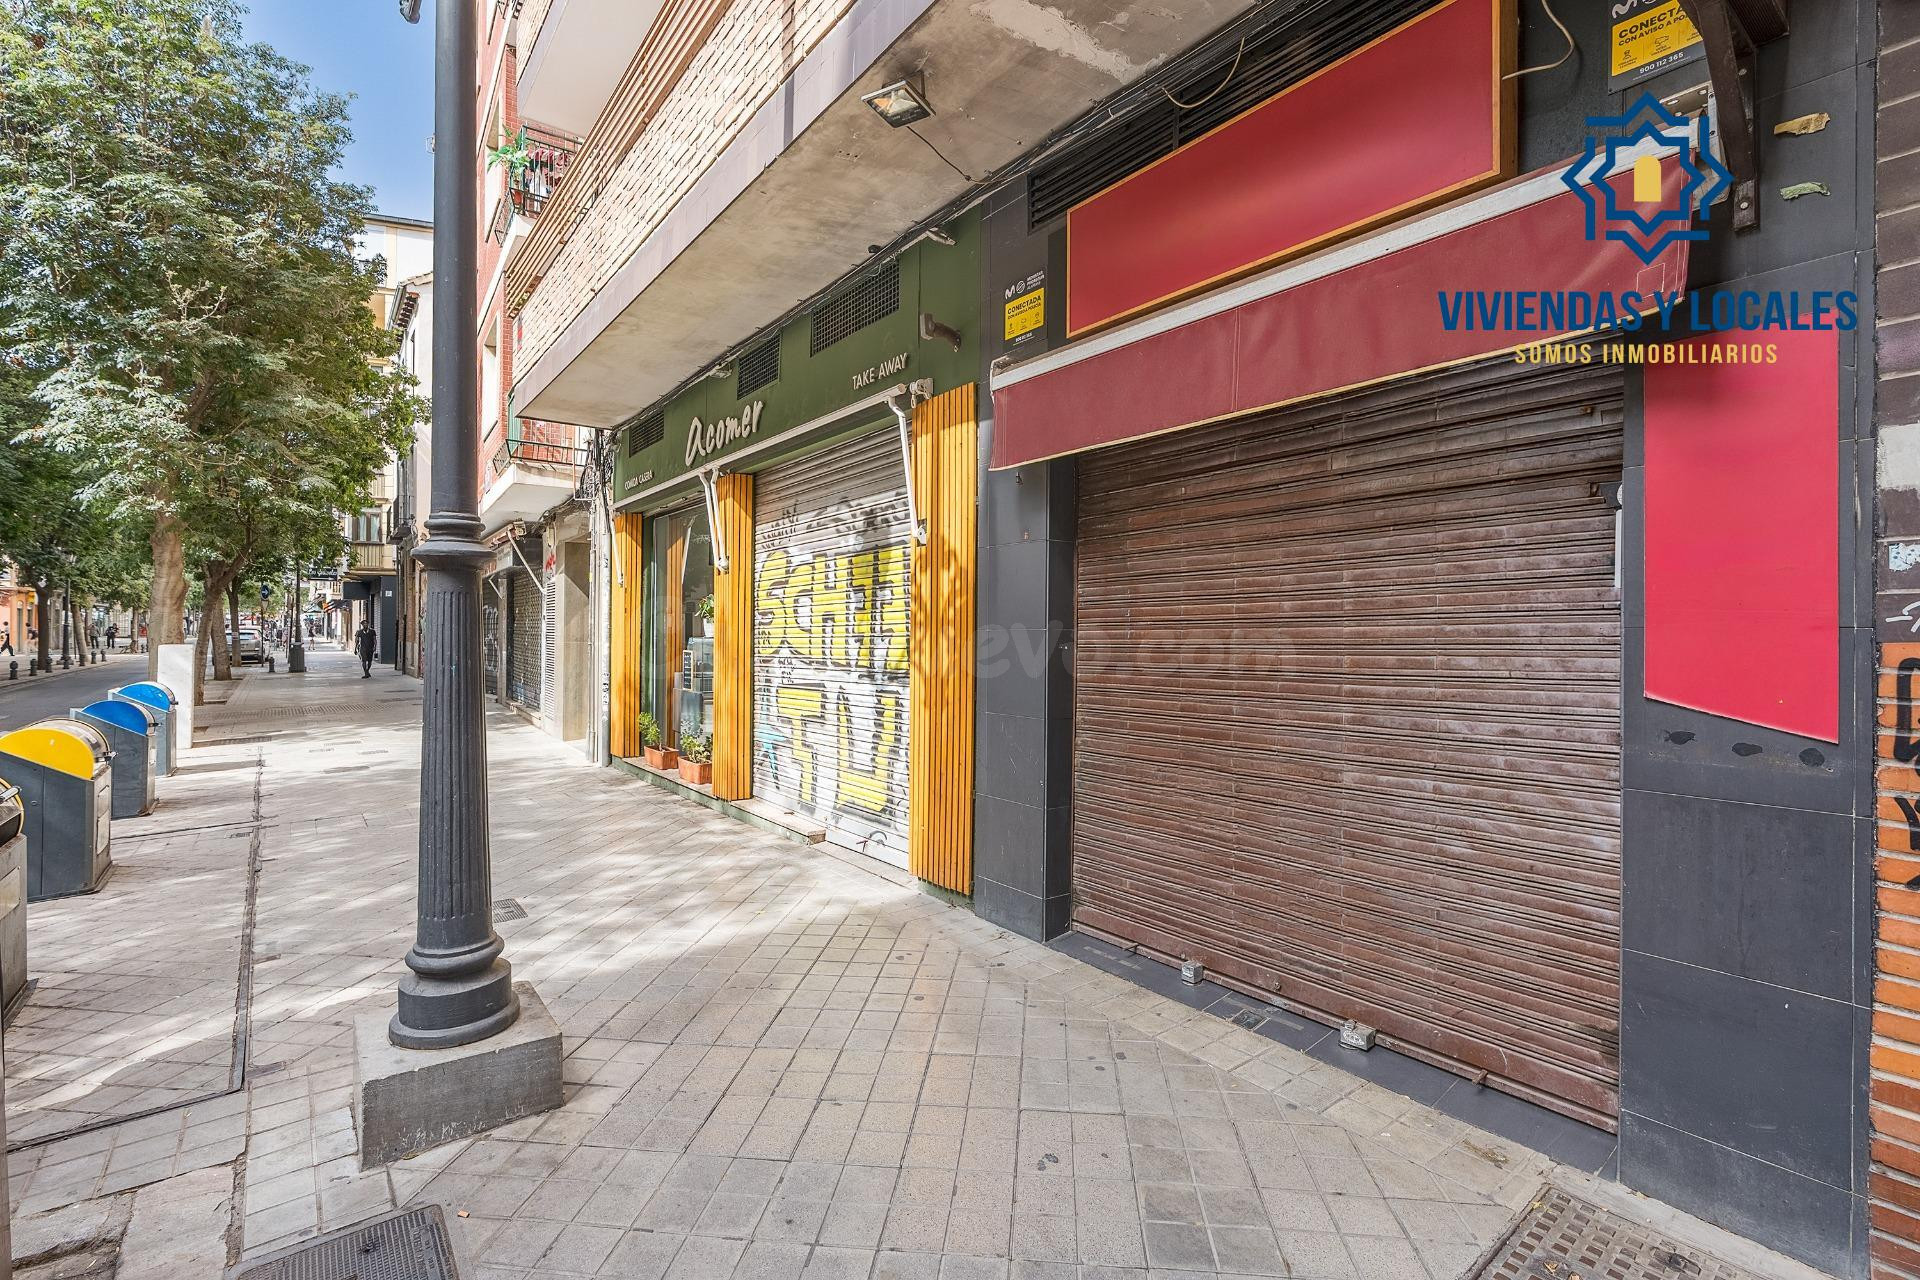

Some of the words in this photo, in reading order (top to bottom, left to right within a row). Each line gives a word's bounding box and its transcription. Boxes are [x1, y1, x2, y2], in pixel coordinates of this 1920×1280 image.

[1618, 34, 1637, 46] CON
[1638, 23, 1664, 39] AVISO
[1673, 14, 1687, 24] PO
[1639, 63, 1655, 74] 900
[1008, 296, 1041, 314] CONECTADA
[852, 367, 876, 391] TAKE
[878, 352, 908, 380] AWAY
